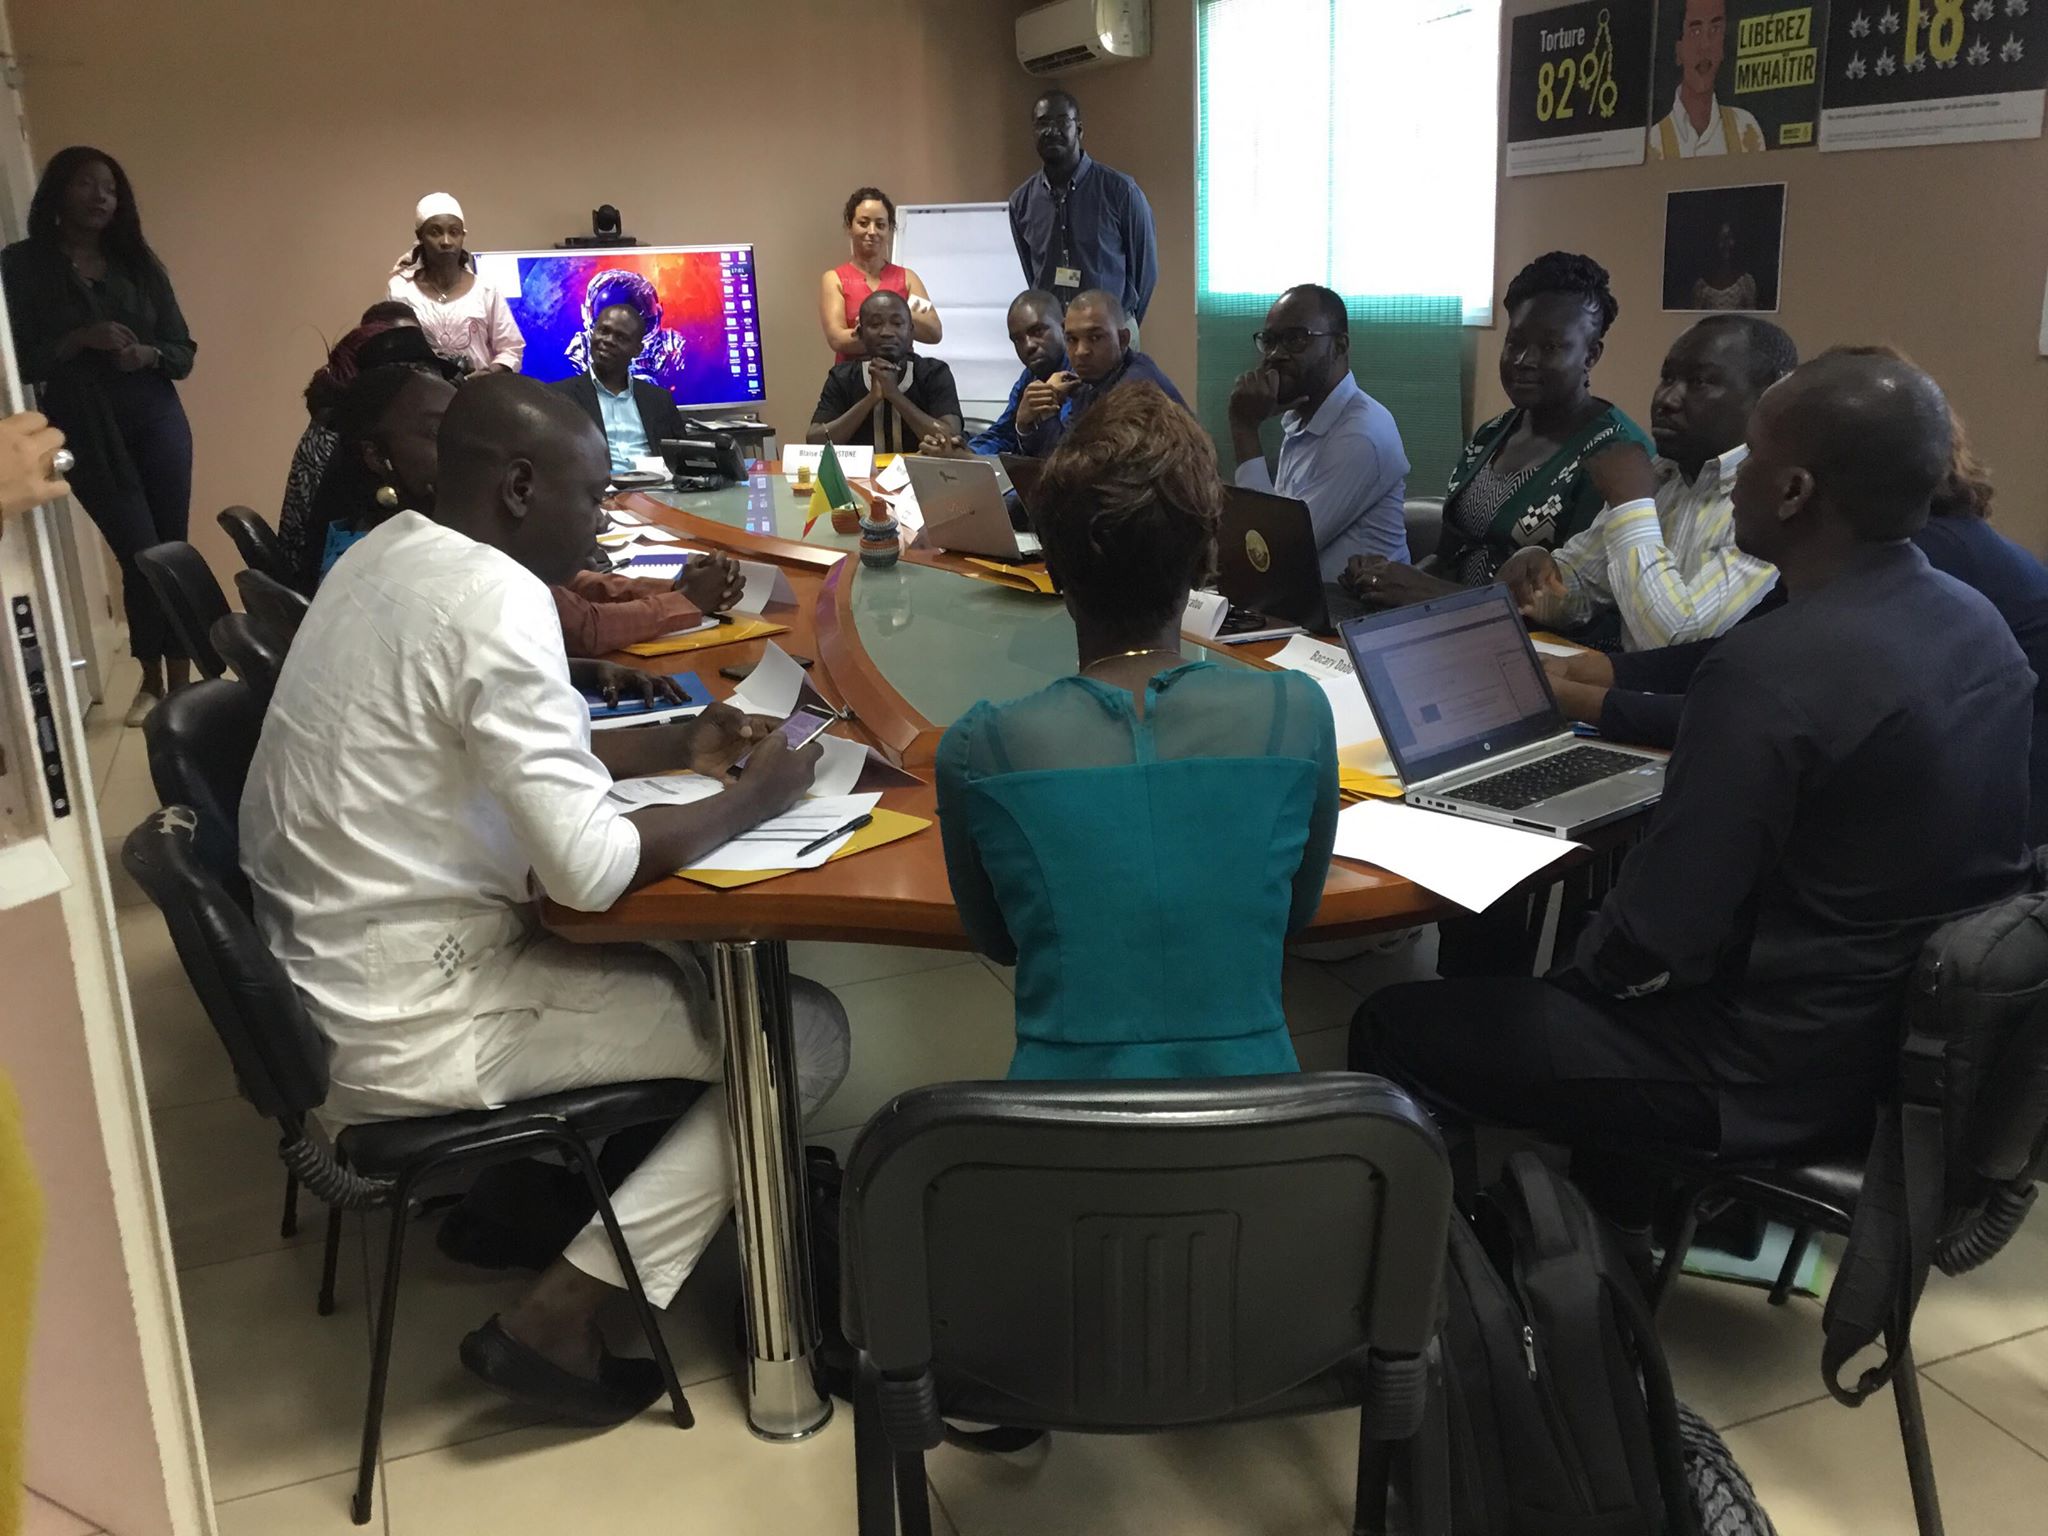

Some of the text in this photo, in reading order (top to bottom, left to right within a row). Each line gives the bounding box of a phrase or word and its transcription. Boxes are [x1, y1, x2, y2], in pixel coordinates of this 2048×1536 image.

[1540, 27, 1585, 52] Torture
[1739, 13, 1806, 49] LIBÉREZ
[1737, 51, 1815, 90] MKHAÏTIR
[799, 449, 818, 457] Blaise
[1310, 650, 1337, 668] Bacary
